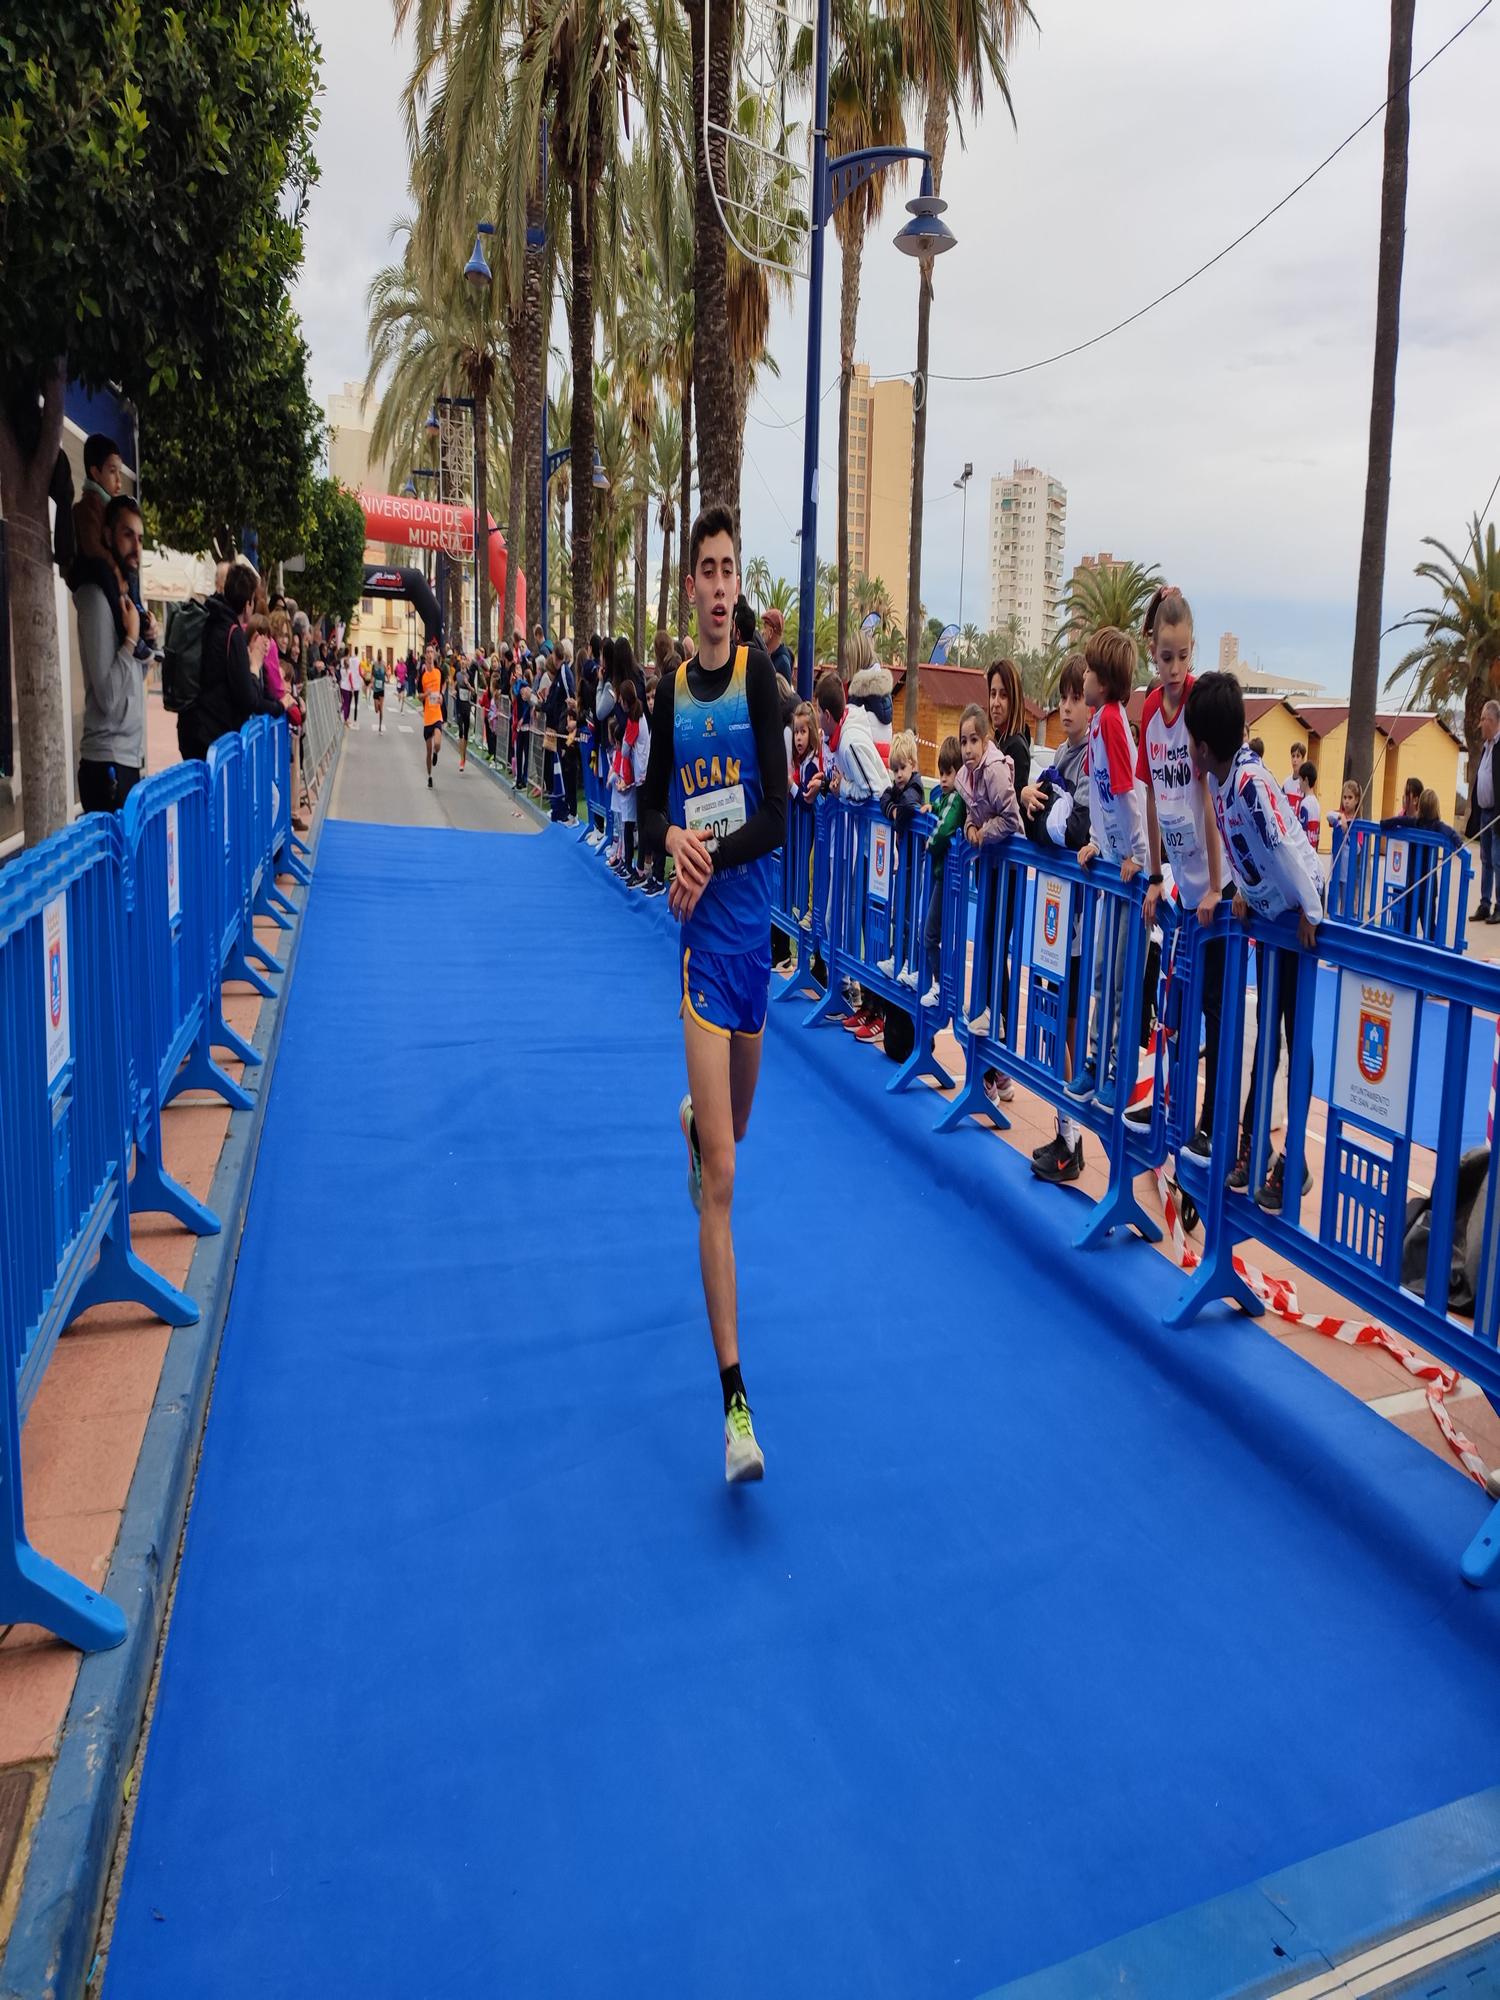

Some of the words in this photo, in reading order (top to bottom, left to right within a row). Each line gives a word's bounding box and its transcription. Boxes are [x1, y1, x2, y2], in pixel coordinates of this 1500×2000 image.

[359, 496, 441, 524] NIVERSIDAD
[445, 509, 463, 527] DE
[409, 527, 461, 551] MURCIA
[680, 756, 741, 795] UCAM
[1165, 832, 1184, 847] 602
